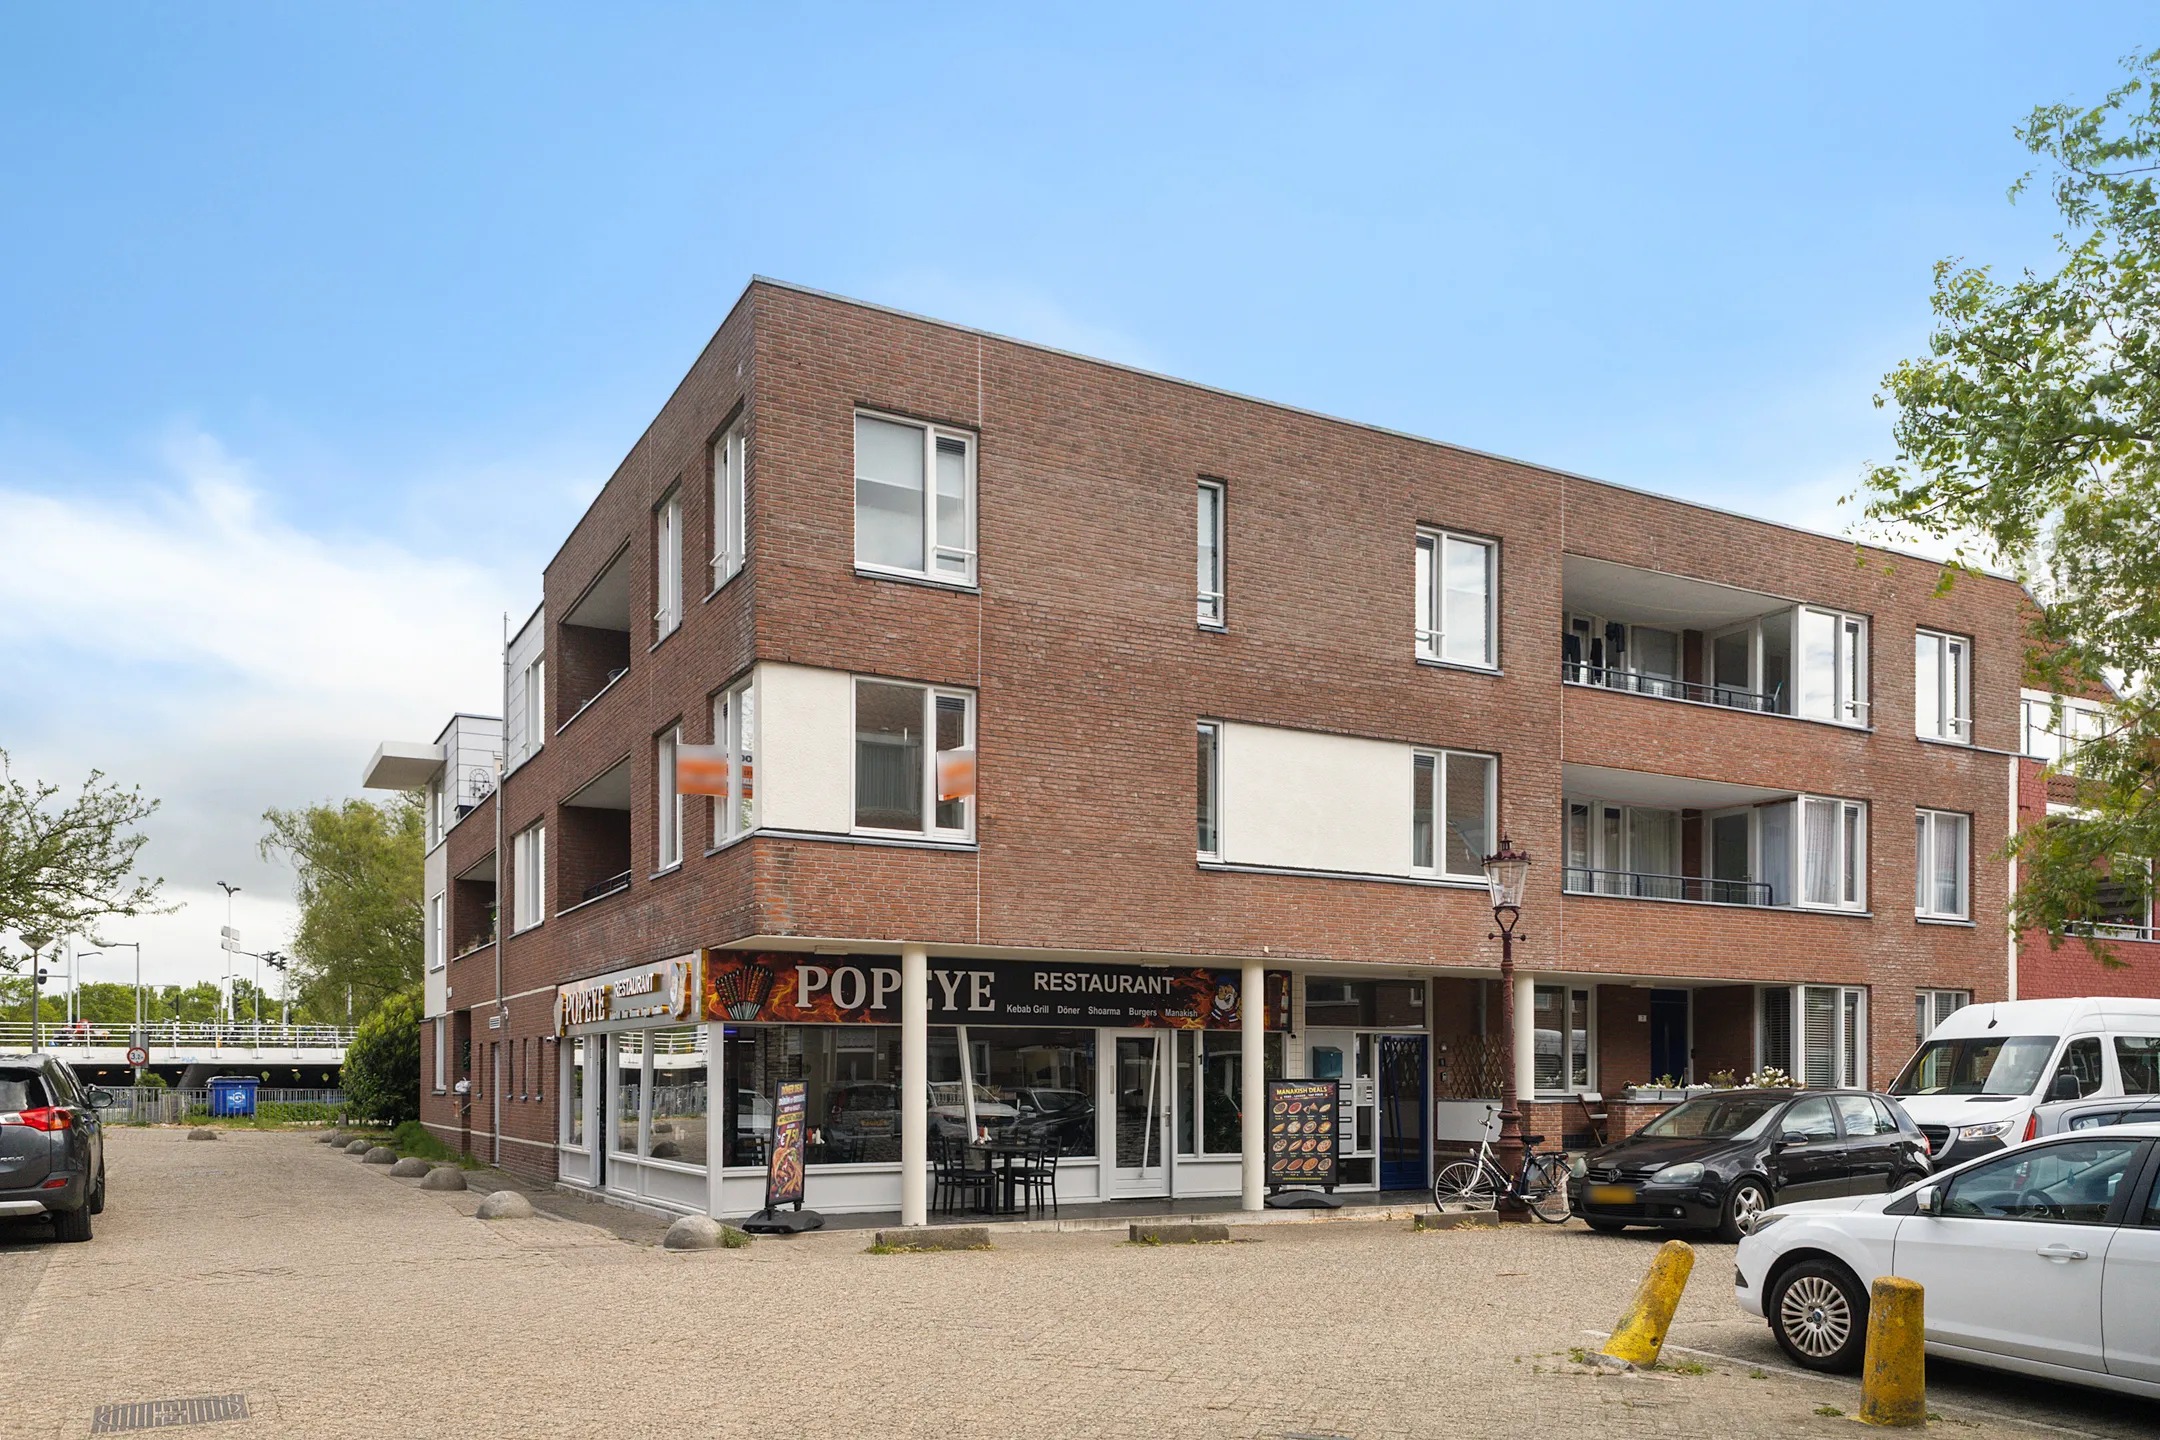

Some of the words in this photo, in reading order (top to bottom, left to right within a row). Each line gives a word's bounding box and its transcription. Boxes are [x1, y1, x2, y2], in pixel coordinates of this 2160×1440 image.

[614, 972, 655, 998] RESTAURANT
[794, 965, 996, 1012] POPYE
[1034, 972, 1174, 995] RESTAURANT
[565, 985, 606, 1025] POPEYE
[1006, 1003, 1032, 1014] Kebab
[1033, 1004, 1049, 1015] Grill
[1057, 1005, 1080, 1015] Döner
[1088, 1006, 1121, 1016] Shoarma
[1128, 1007, 1157, 1018] Burgers
[1165, 1008, 1198, 1018] Manakish
[1276, 1087, 1308, 1095] MANAKISH
[1308, 1086, 1328, 1094] DEALS
